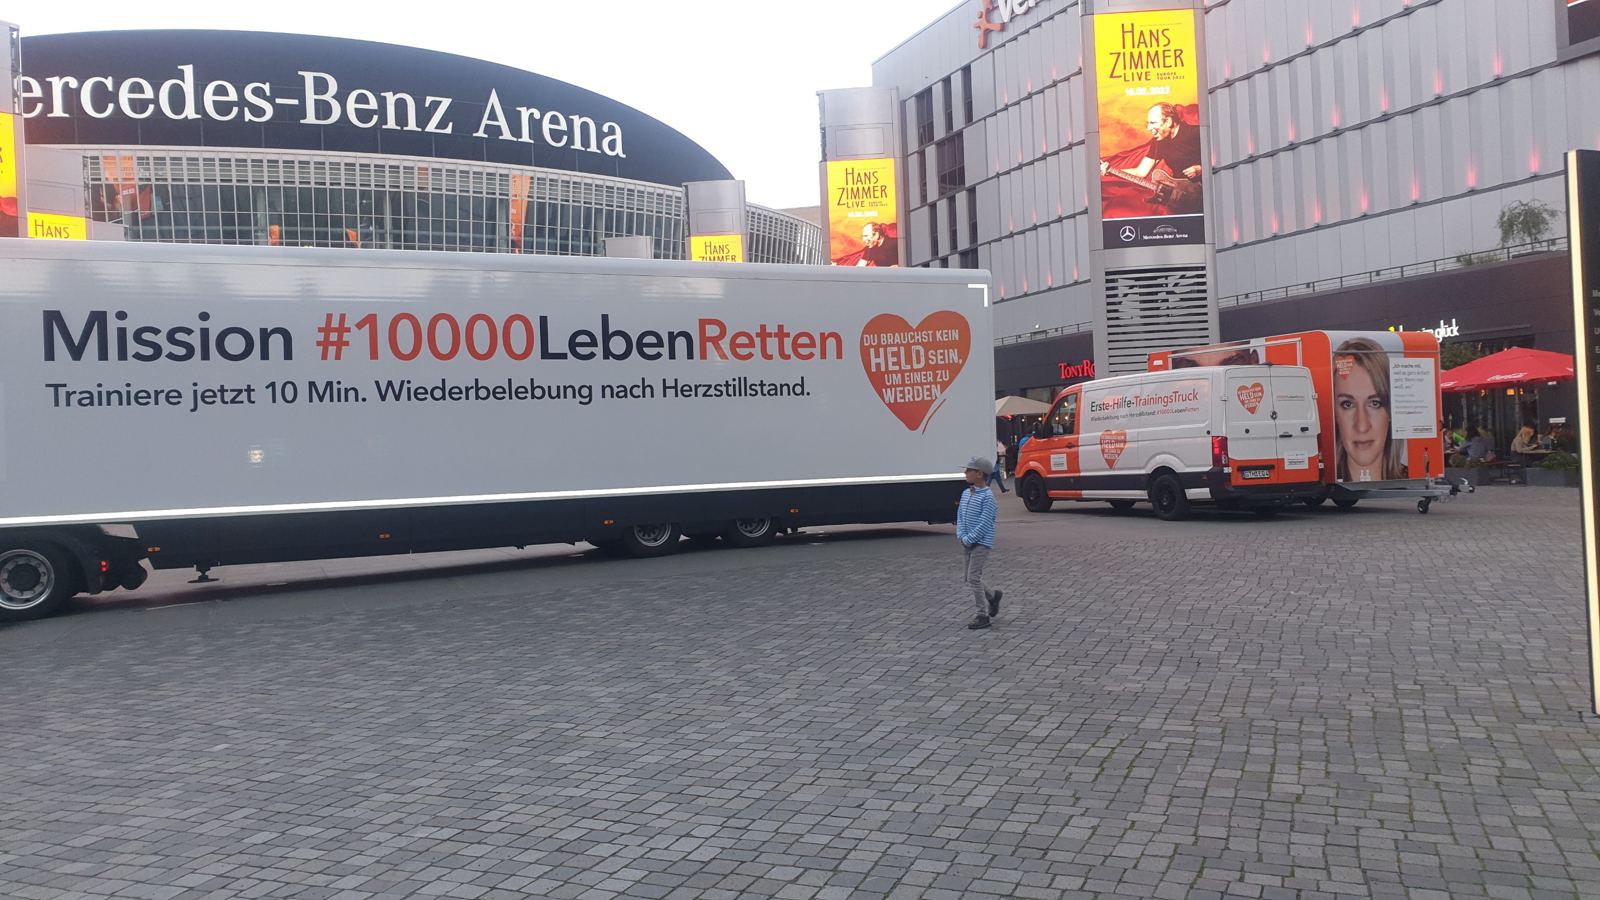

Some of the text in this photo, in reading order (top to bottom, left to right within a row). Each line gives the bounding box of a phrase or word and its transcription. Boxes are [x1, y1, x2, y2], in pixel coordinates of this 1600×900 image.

[1121, 23, 1171, 49] HANS
[1109, 49, 1185, 78] ZIMMER
[1123, 71, 1151, 82] LIVE
[20, 64, 626, 158] ercedes-Benz Arena
[845, 168, 879, 186] HANS
[837, 185, 888, 206] ZIMMER
[846, 200, 865, 209] LIVE
[34, 218, 70, 239] HANS
[704, 241, 731, 255] HANS
[42, 309, 843, 362] Mission #10000LebenRetten
[863, 329, 959, 346] DU BRAUCHST KEIN
[869, 345, 962, 372] HELD SEIN,
[884, 370, 950, 386] UM EINER ZU
[45, 376, 811, 412] Trainiere jetzt 10 Min. Wiederbelebung nach Herzstillstand.
[882, 384, 941, 404] WERDEN
[1090, 388, 1199, 412] Erste-Hilfe-TrainingsTruck
